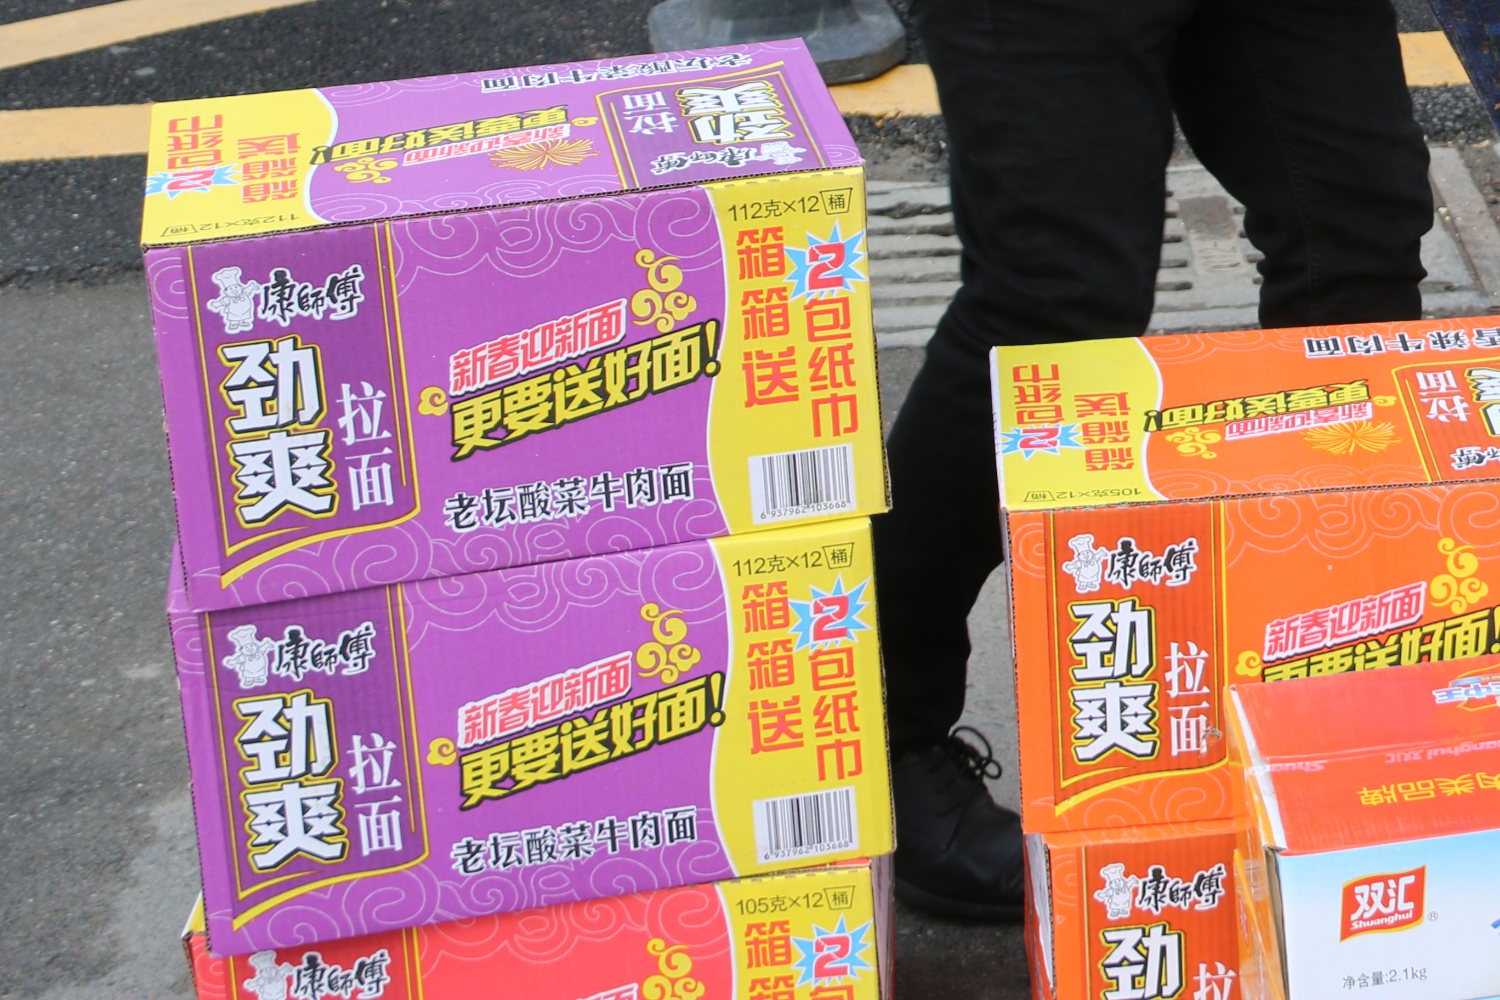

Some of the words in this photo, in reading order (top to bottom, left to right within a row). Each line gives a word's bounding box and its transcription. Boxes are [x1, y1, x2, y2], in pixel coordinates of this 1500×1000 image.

[481, 52, 753, 93] 老坛酸菜牛肉面
[402, 124, 571, 166] 新春迎新面
[622, 91, 682, 135] 拉面
[677, 80, 794, 145] 劲爽
[261, 266, 365, 324] 康師傅
[736, 225, 799, 408] 箱箱送
[804, 242, 860, 439] 2包纸巾
[449, 298, 627, 395] 新春迎新面
[450, 320, 721, 461] 更要送好面!
[1012, 364, 1063, 450] 2包纸巾
[1225, 401, 1373, 440] 新春迎新面
[1416, 370, 1472, 422] 拉面
[217, 334, 339, 528] 劲爽
[336, 381, 394, 511] 拉面
[1074, 392, 1136, 471] 箱箱送
[444, 461, 694, 531] 老坛酸菜牛肉面
[1106, 537, 1198, 588] 康師傅
[274, 622, 377, 679] 康師傅
[1264, 581, 1427, 661] 新春迎新面
[459, 651, 633, 748] 新春迎新面
[741, 580, 804, 755] 箱箱送
[808, 594, 863, 782] 2包纸巾
[1067, 596, 1159, 763] 劲爽
[1164, 641, 1211, 757] 拉面
[458, 671, 727, 811] 更要送好面!
[232, 689, 349, 873] 劲爽
[347, 732, 403, 857] 拉面
[451, 804, 698, 874] 老坛酸菜牛肉面
[1137, 863, 1226, 914] 康師傅
[1350, 909, 1413, 931] Shuanghui
[1351, 874, 1416, 919] 双汇
[1342, 965, 1428, 990] 净含量:2.1kg
